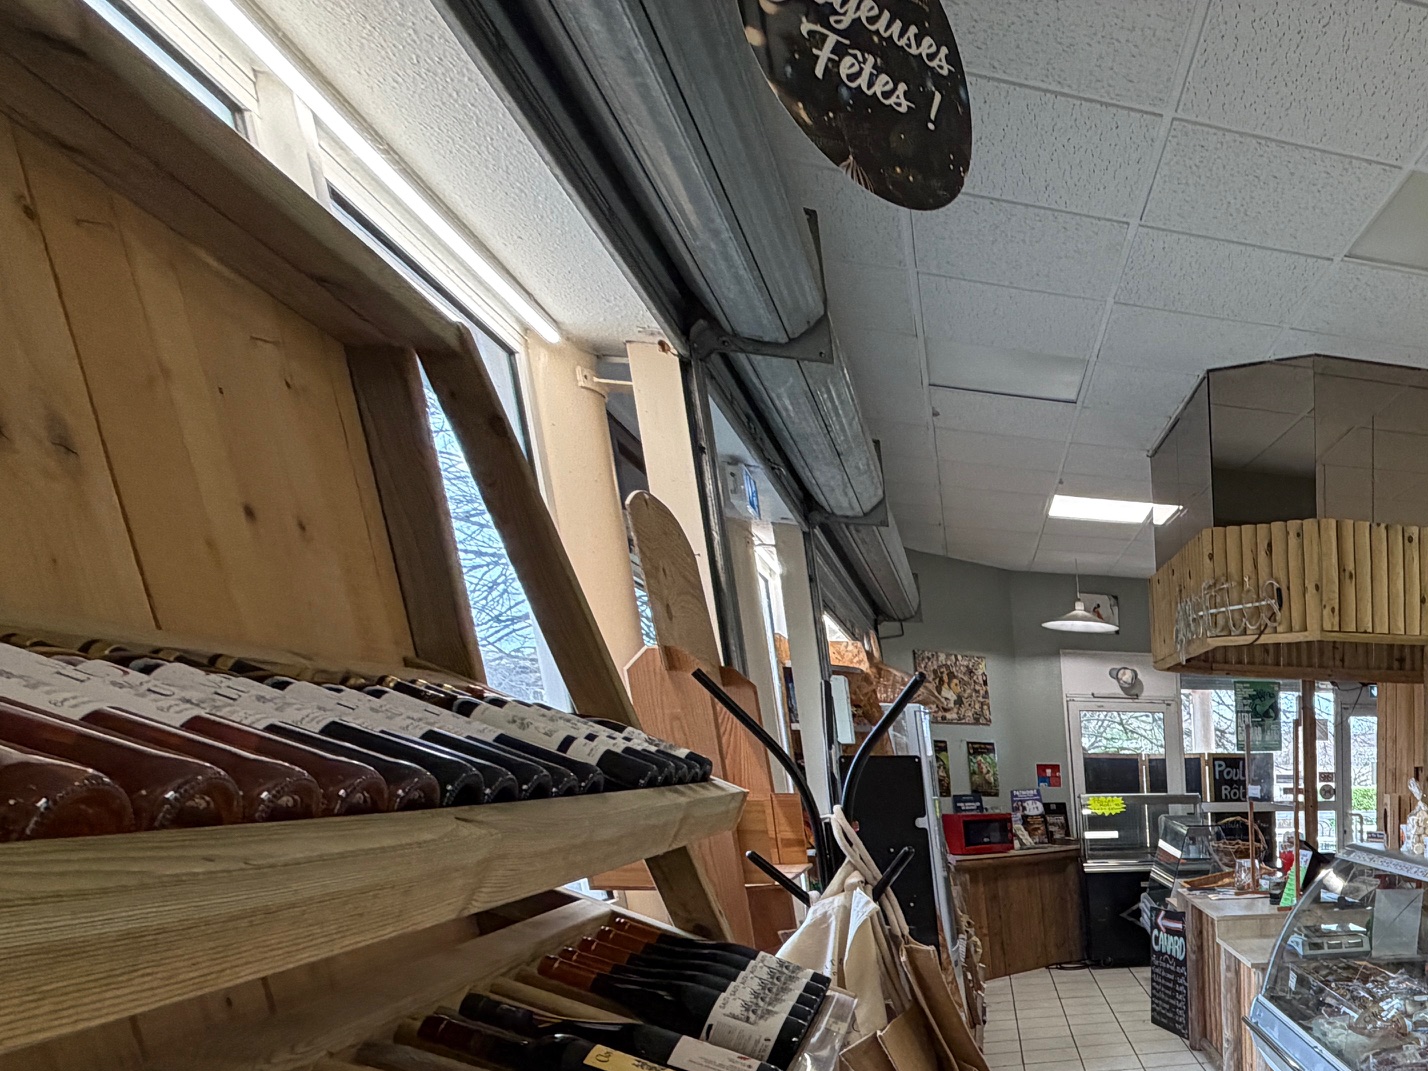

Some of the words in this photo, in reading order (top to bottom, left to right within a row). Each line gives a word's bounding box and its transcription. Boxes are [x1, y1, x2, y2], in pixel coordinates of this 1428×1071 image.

[801, 16, 915, 113] Fêtes
[927, 91, 941, 130] !
[1222, 785, 1246, 800] Rôt
[1152, 929, 1185, 961] CANARD
